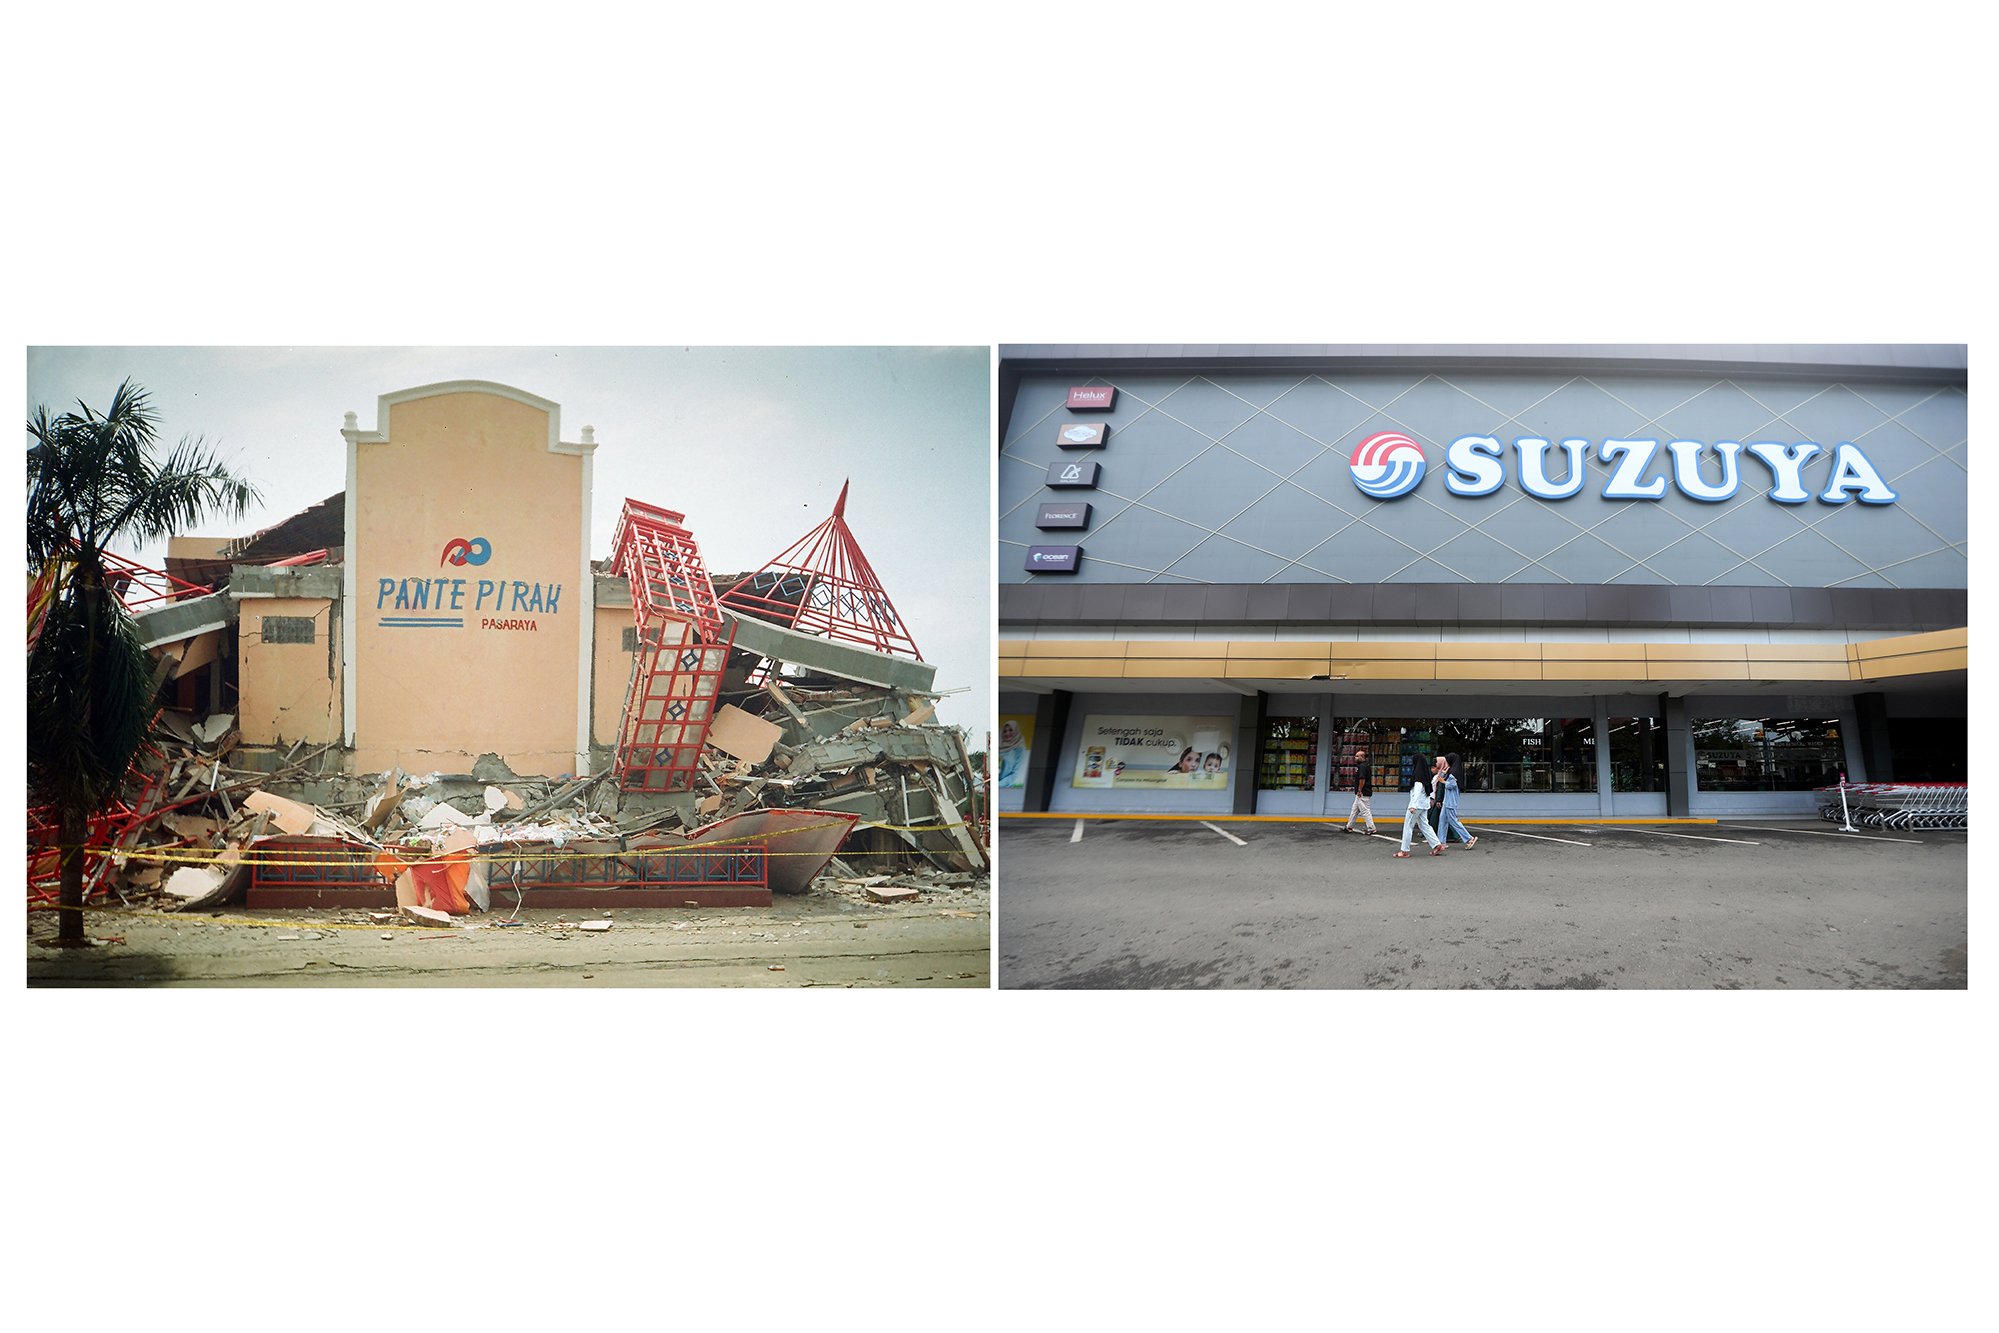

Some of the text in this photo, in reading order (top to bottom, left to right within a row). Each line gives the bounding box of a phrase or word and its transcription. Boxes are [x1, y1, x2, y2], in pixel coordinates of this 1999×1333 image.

[1073, 391, 1106, 399] Helux
[1443, 433, 1901, 506] SUZUYA
[1045, 512, 1078, 520] FLORENCE
[377, 578, 562, 614] PANTE PIRAK
[481, 618, 537, 631] PASARAYA
[1097, 726, 1164, 738] Setengah saja
[1114, 737, 1177, 748] TIDAK cukup.
